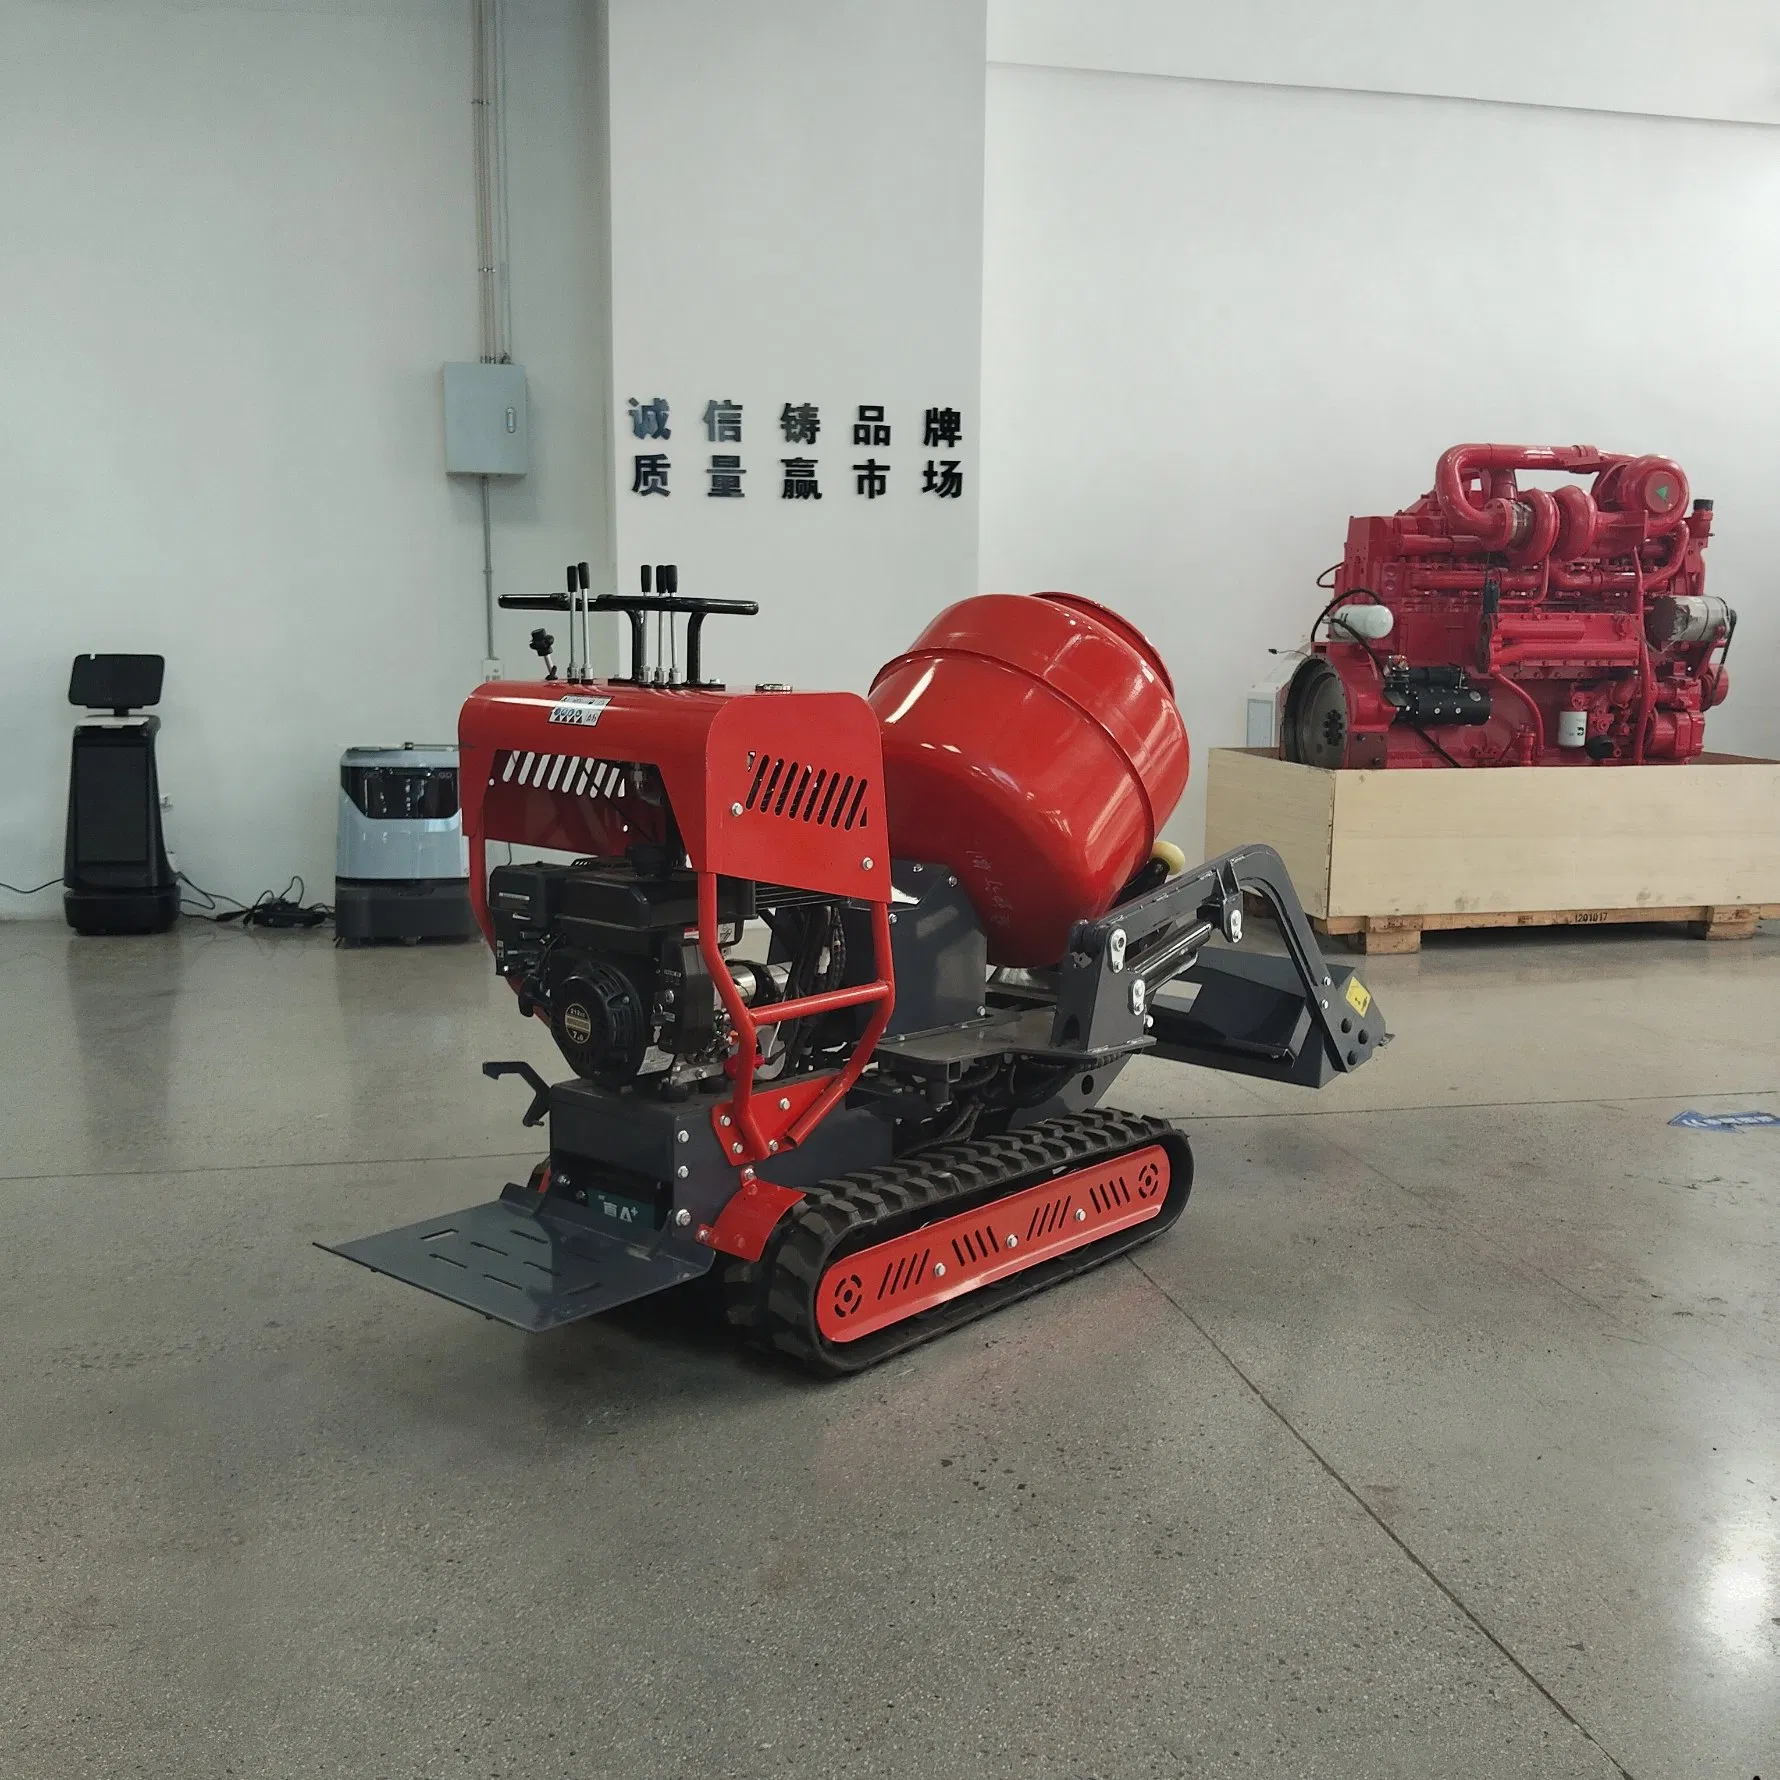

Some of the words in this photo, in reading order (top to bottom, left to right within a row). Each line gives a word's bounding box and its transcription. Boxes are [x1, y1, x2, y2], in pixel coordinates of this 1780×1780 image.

[626, 397, 963, 448] 诚信铸品牌
[631, 453, 964, 499] 质量赢市场
[1575, 912, 1608, 922] 1201017
